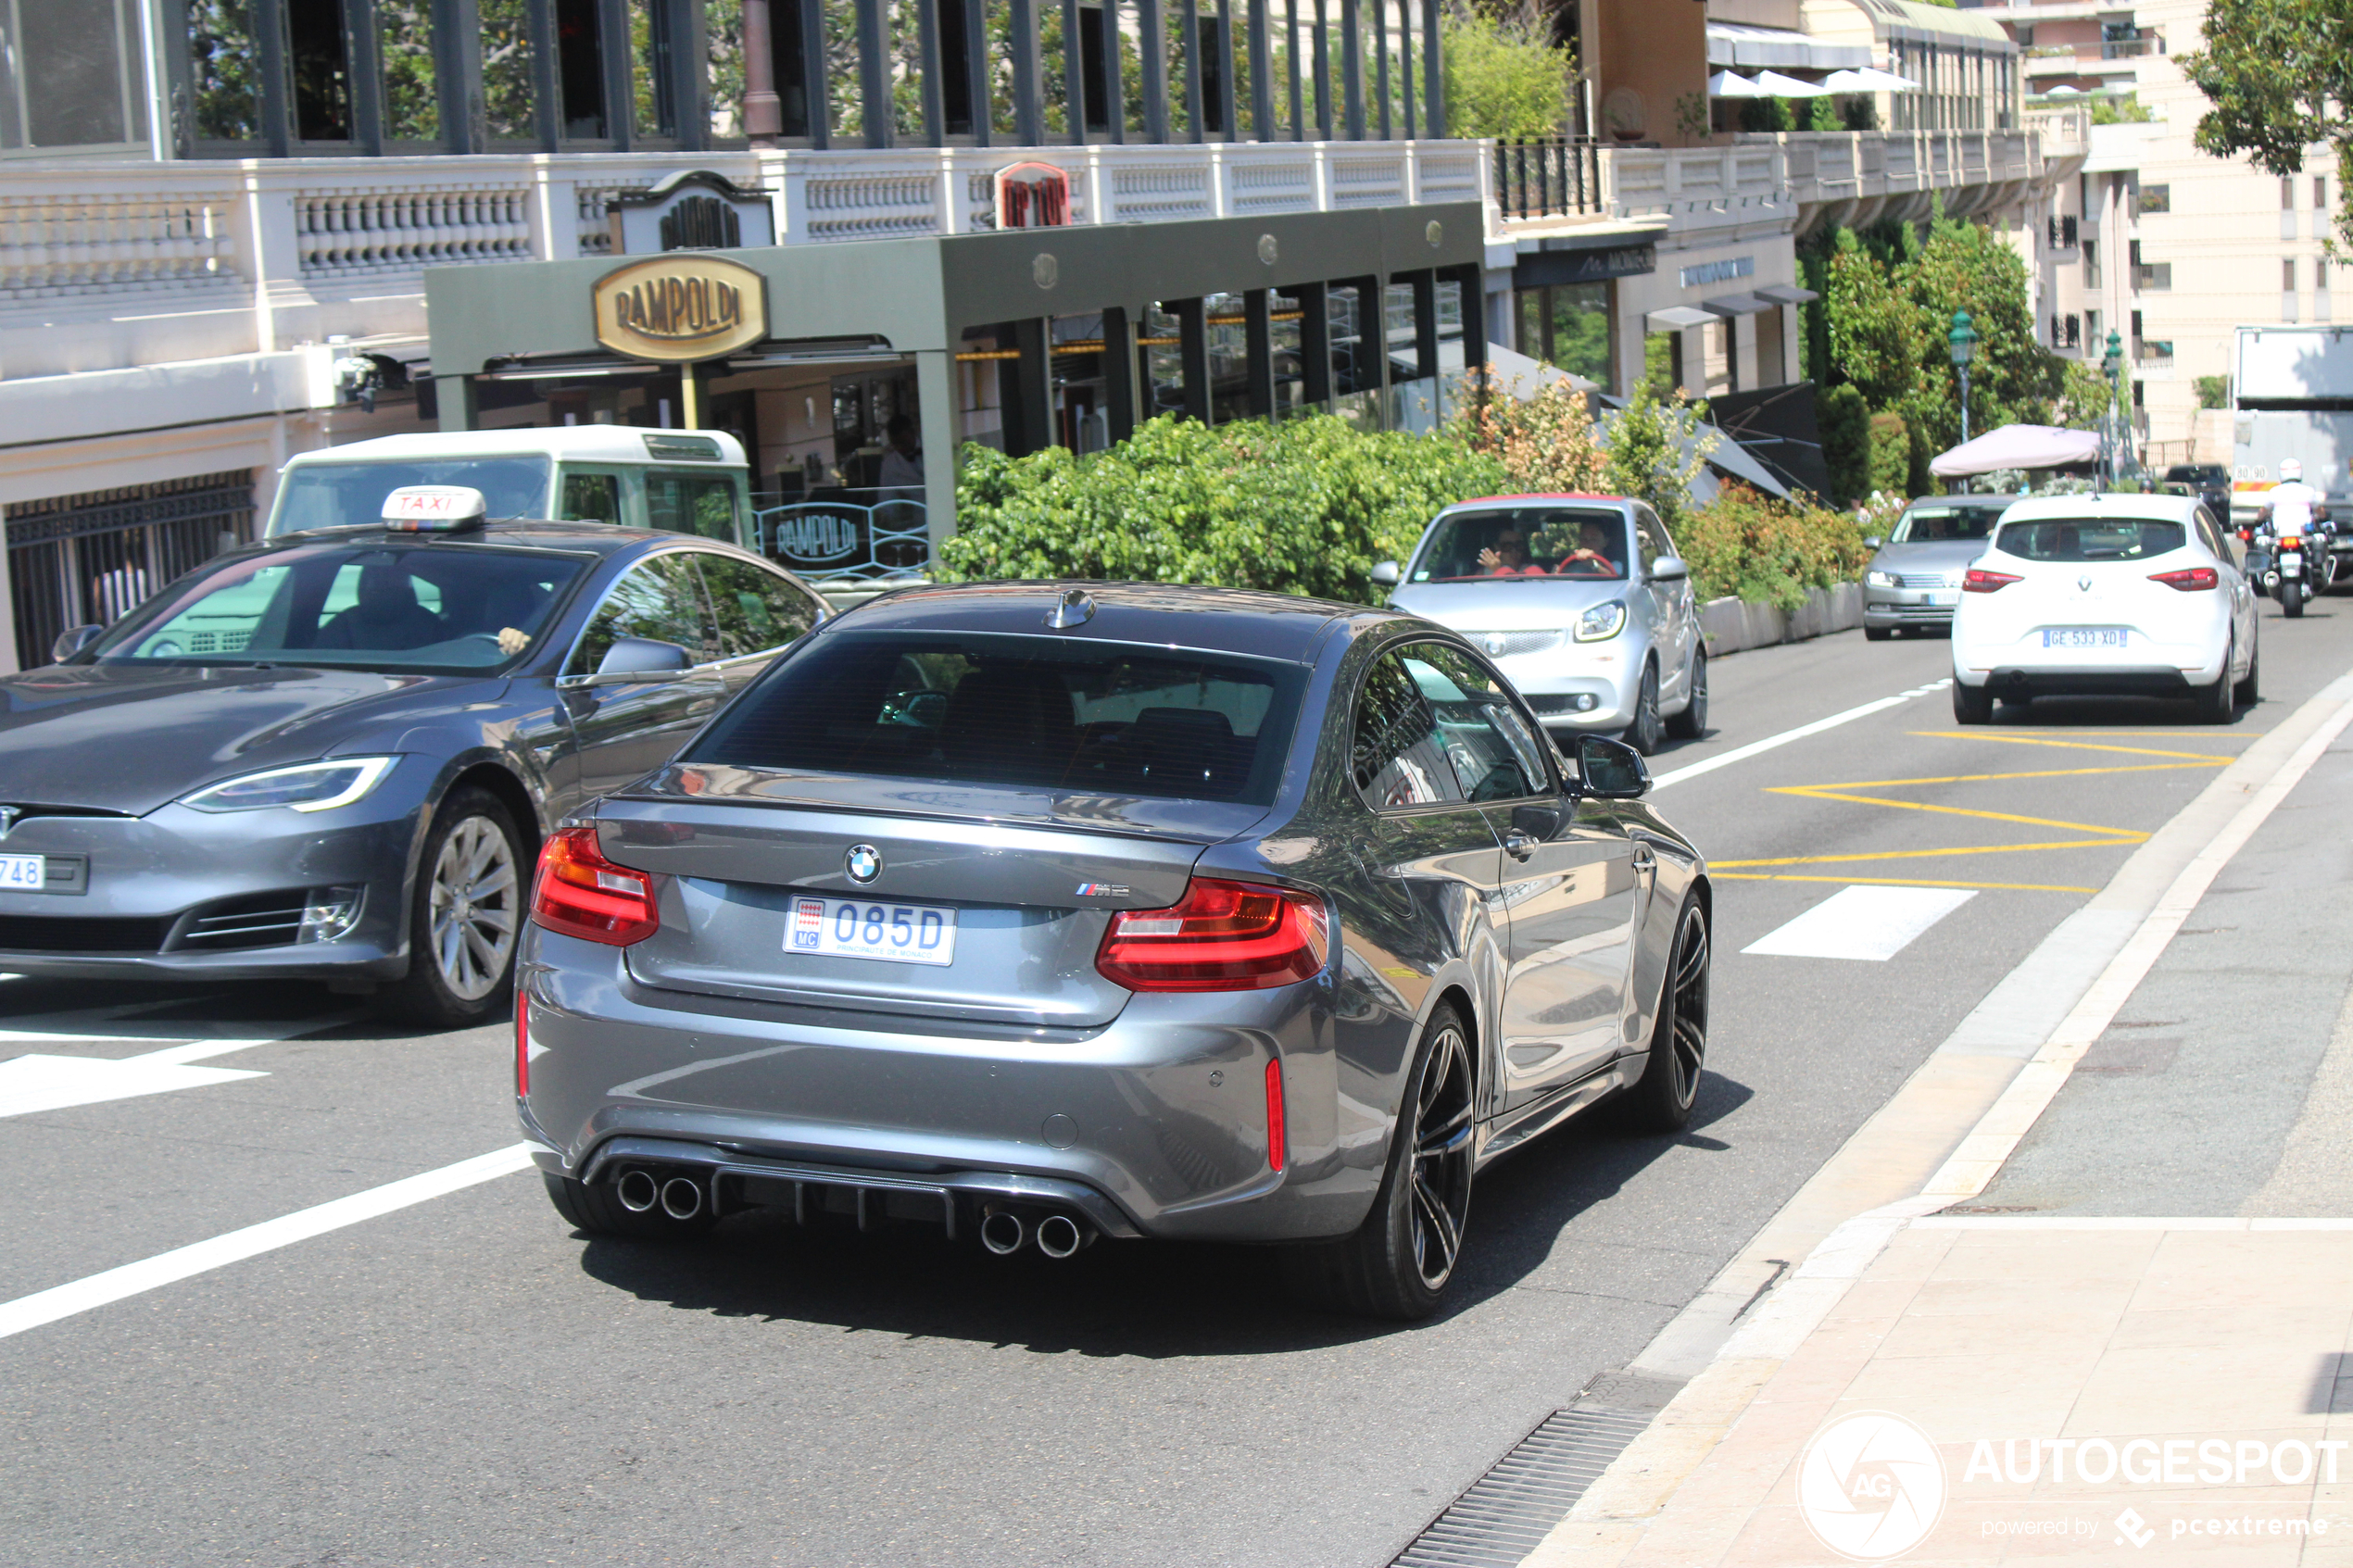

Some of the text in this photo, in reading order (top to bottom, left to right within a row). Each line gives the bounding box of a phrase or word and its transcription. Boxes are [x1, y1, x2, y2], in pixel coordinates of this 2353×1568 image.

[615, 277, 740, 340] RAMPOLDI
[2236, 467, 2266, 479] 80 90
[400, 496, 452, 511] TAXI
[776, 515, 858, 561] RAMPOLDI
[1091, 883, 1129, 897] M2
[835, 904, 943, 950] 085D
[798, 932, 817, 946] MC
[837, 944, 884, 955] PRINCIPAUTE
[900, 949, 933, 960] MONACO
